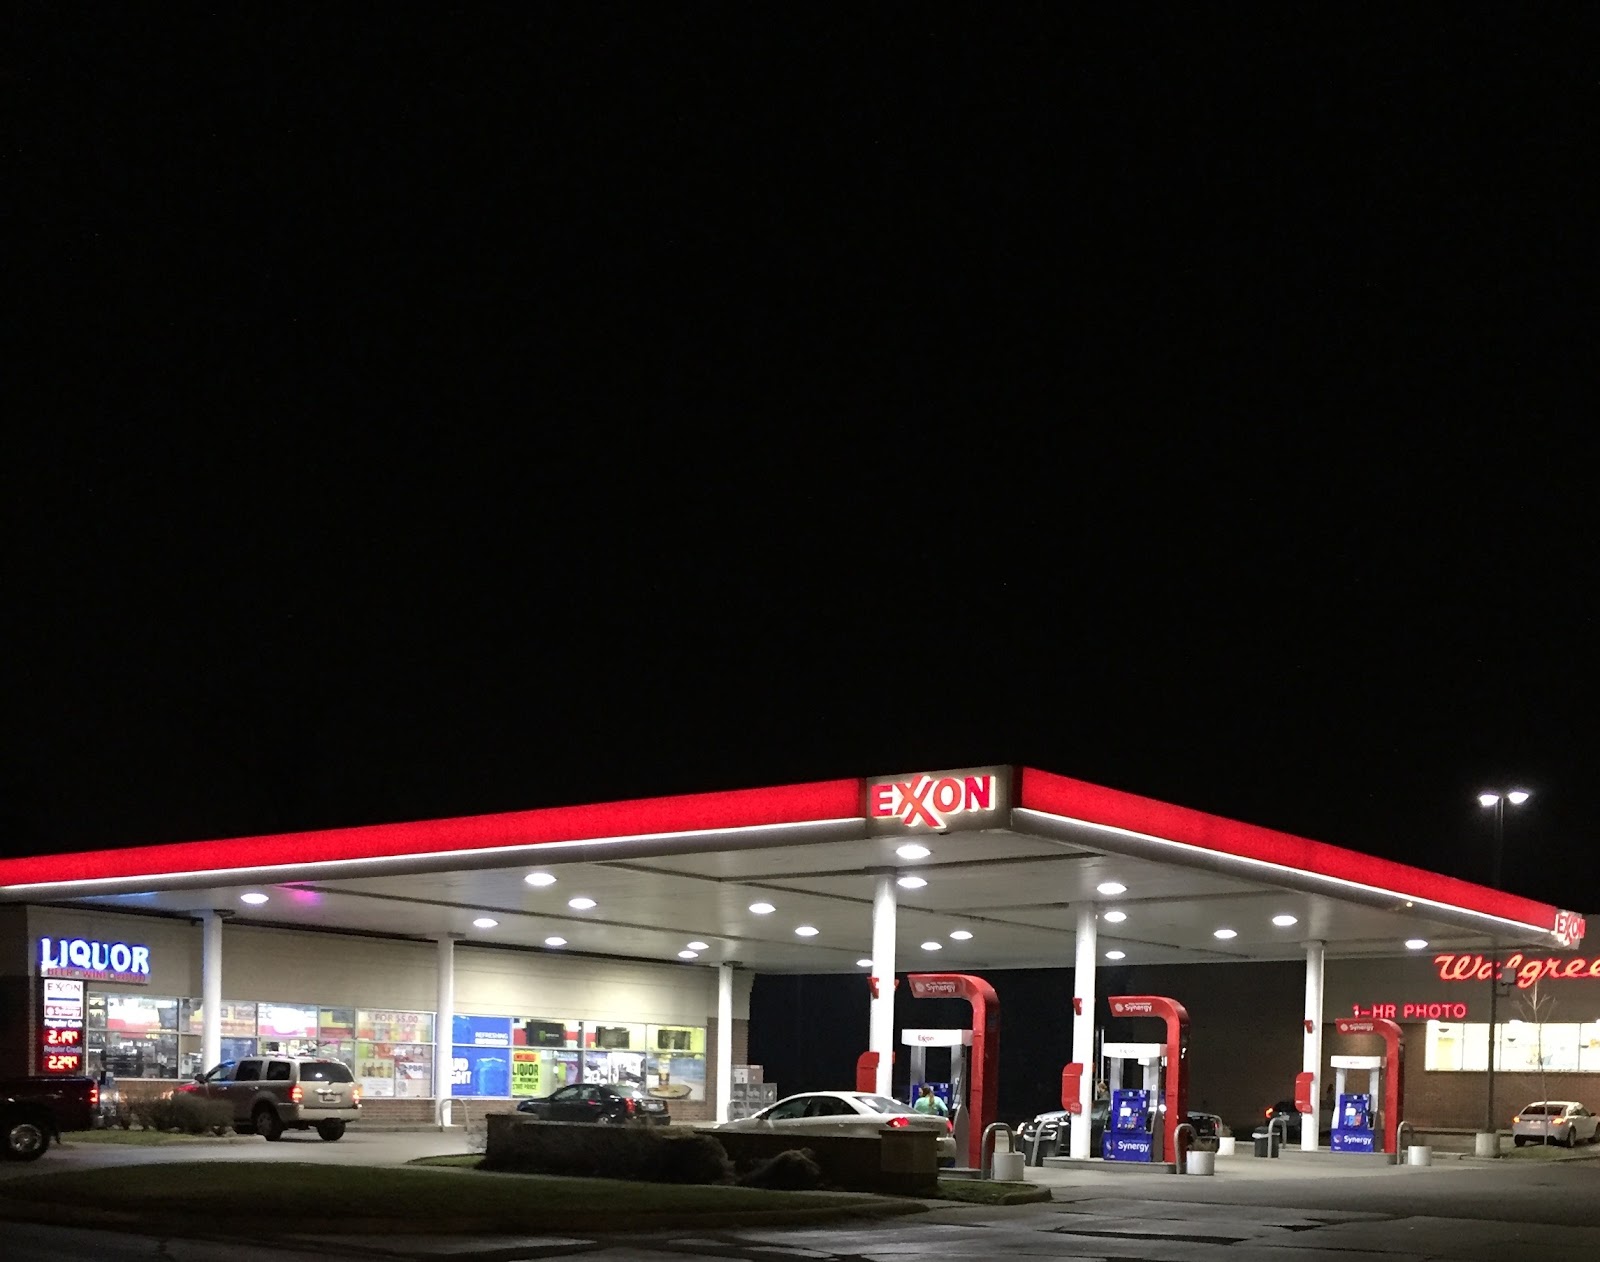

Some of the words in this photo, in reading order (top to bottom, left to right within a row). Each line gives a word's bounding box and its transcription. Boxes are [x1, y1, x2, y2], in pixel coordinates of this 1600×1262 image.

[870, 774, 995, 828] EXXON
[41, 938, 149, 974] LIQUOR
[47, 983, 81, 992] EXXON
[926, 984, 955, 993] Synergy
[1124, 1003, 1152, 1012] Synergy
[1353, 1004, 1397, 1018] 1-HR
[1404, 1003, 1467, 1019] PHOTO
[512, 1063, 539, 1076] LIQUOR
[1344, 1135, 1372, 1145] Synergy
[1118, 1141, 1149, 1153] Synergy
